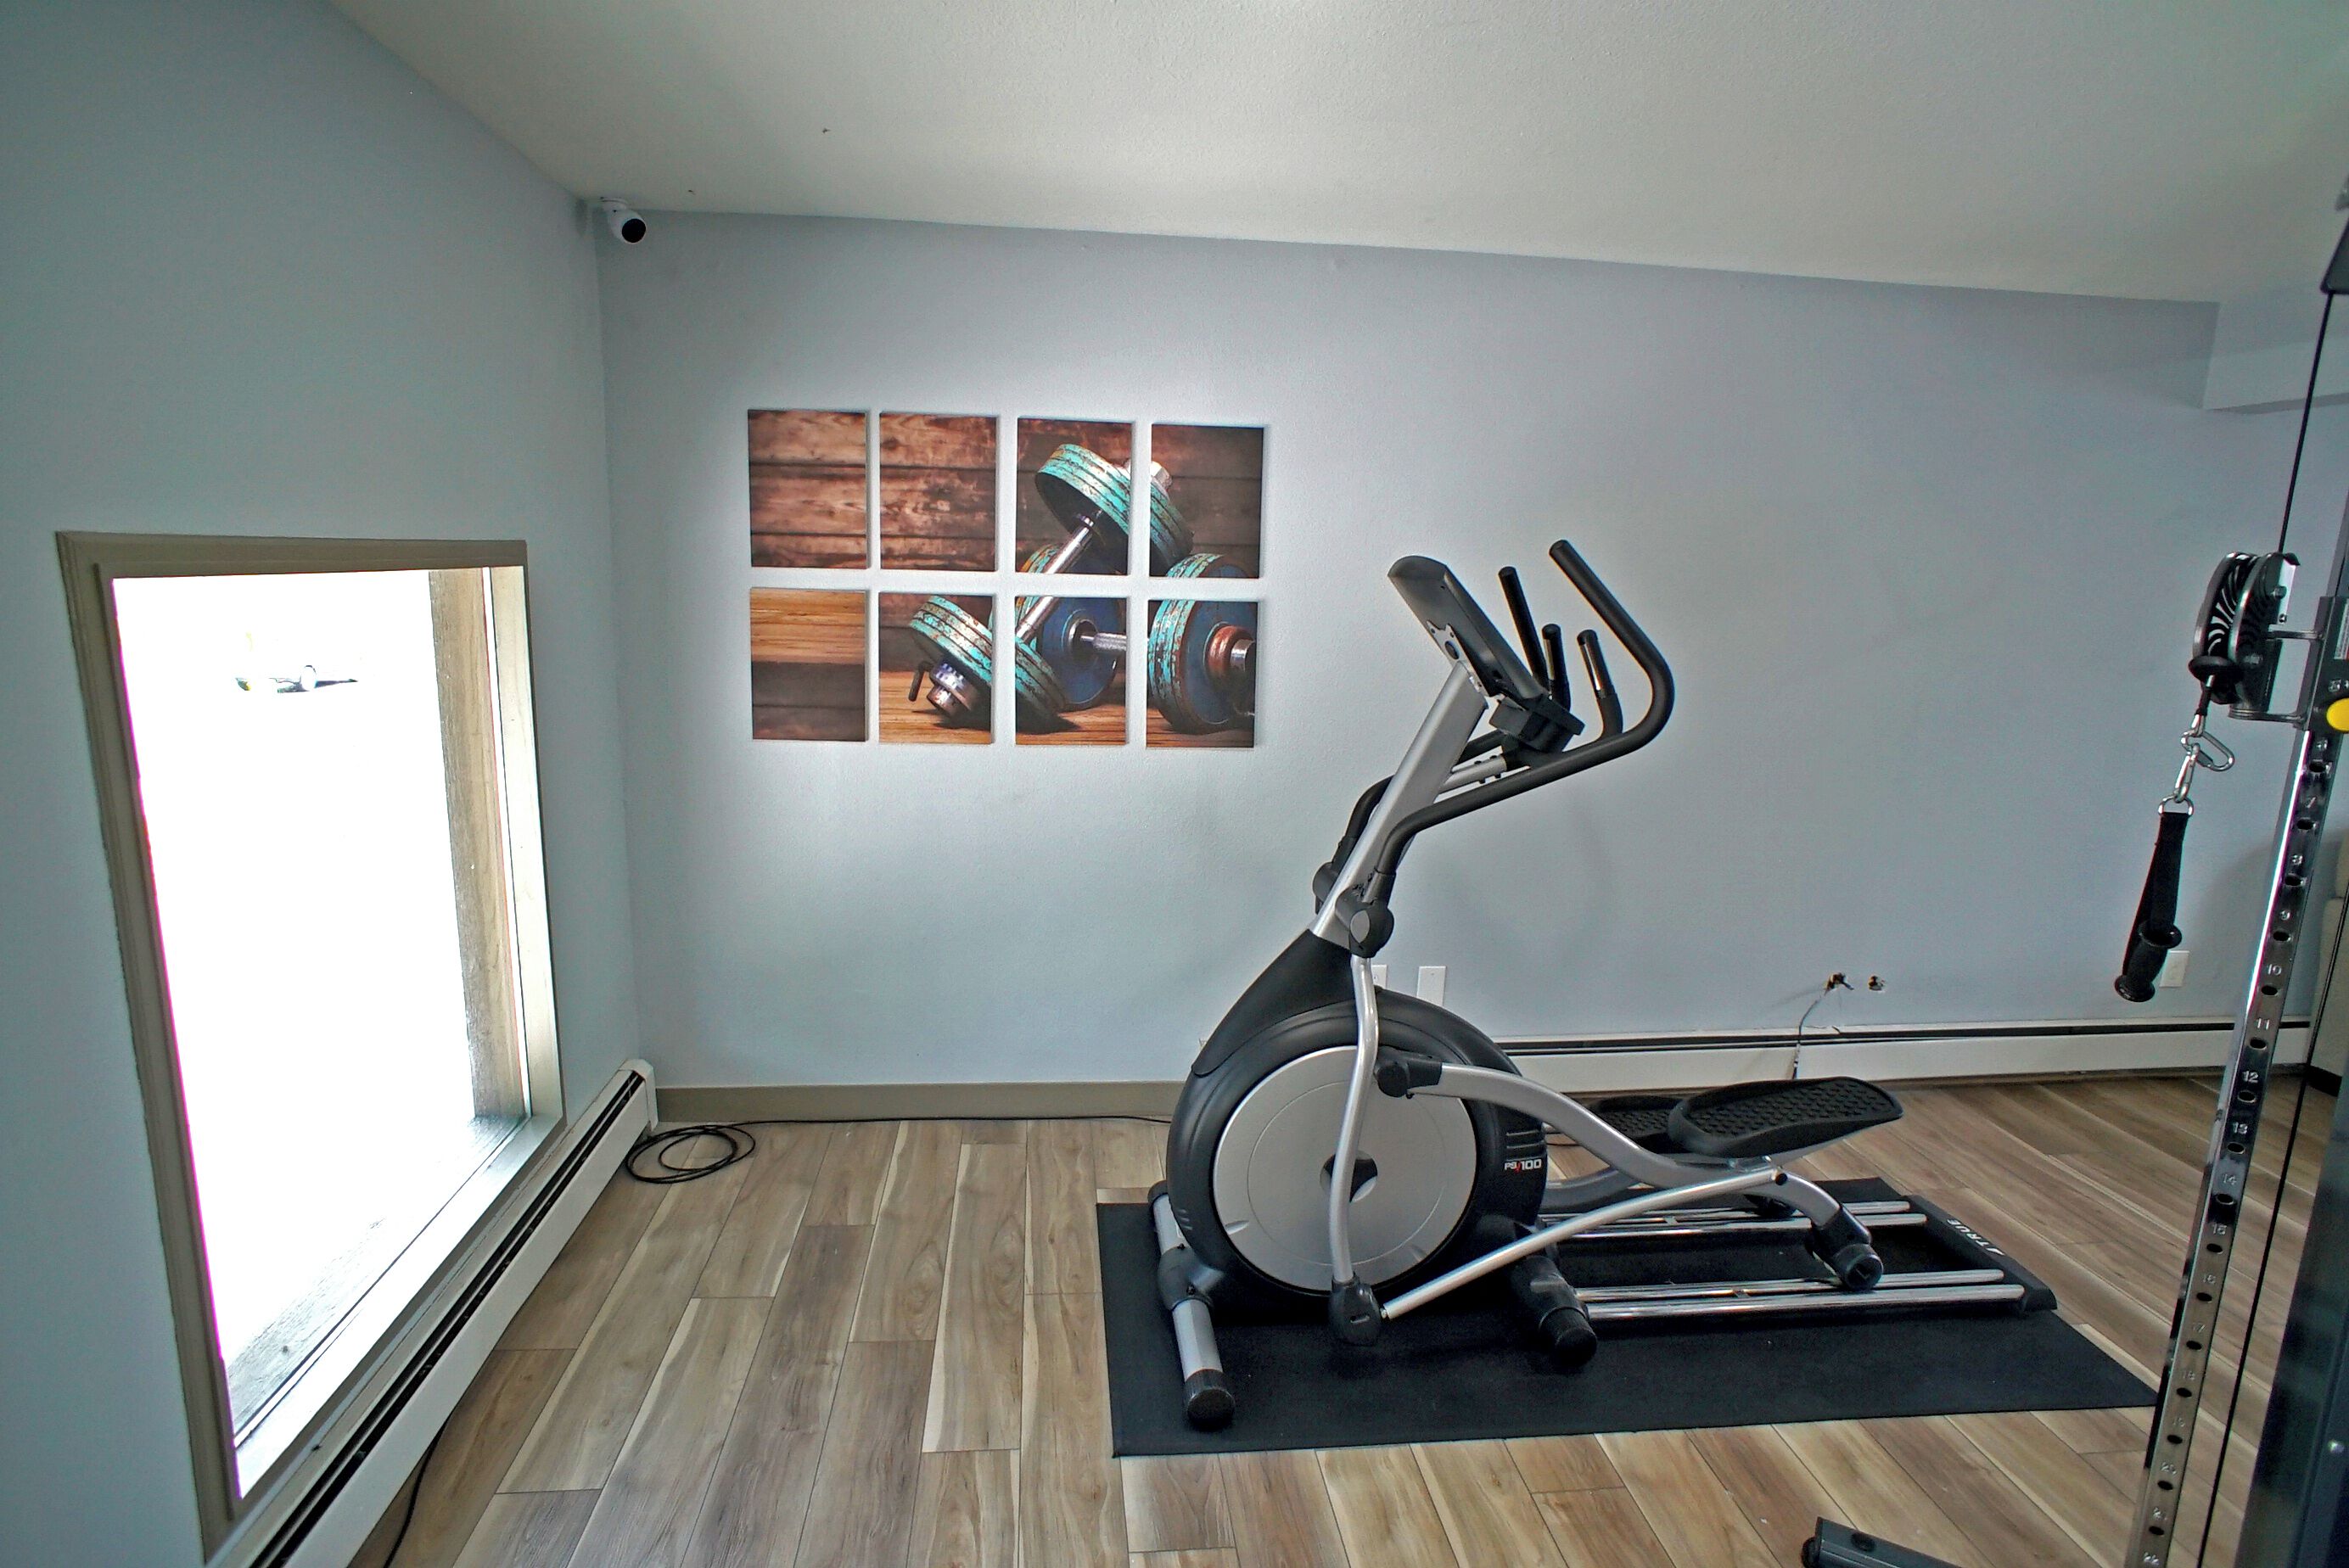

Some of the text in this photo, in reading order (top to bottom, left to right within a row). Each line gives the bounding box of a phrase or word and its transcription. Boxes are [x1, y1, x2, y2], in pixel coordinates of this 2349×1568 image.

[2268, 963, 2282, 976] 10
[2256, 1017, 2270, 1030] 11
[2242, 1070, 2258, 1084] 12
[2232, 1122, 2248, 1134] 13
[2223, 1173, 2237, 1185] 14
[1947, 1218, 1990, 1247] TRUE
